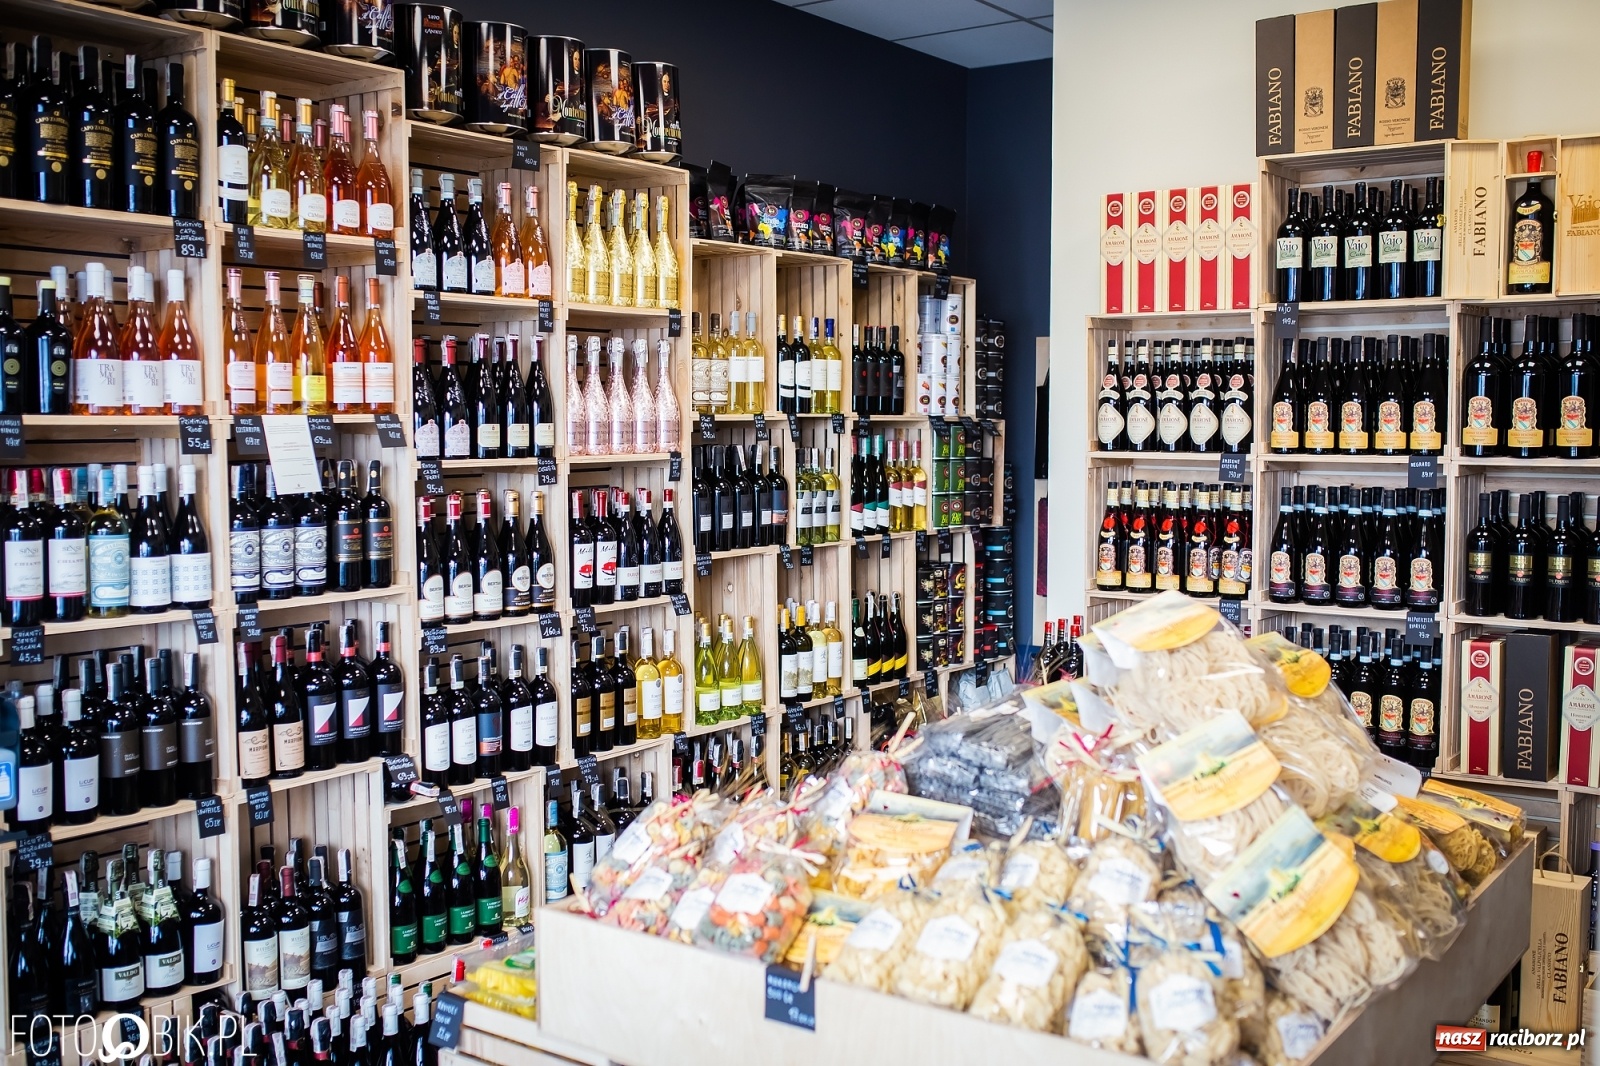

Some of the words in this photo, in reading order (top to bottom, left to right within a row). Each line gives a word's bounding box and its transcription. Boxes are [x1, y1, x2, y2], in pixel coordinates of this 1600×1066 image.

[1429, 46, 1447, 131] FABIANO
[1347, 56, 1364, 138] FABIANO
[1268, 66, 1282, 146] FABIANO
[1474, 186, 1487, 257] FABIANO
[1380, 234, 1403, 246] Vajo
[1415, 232, 1437, 244] Vajo
[1278, 241, 1298, 252] Vajo
[1313, 239, 1334, 251] Vajo
[1346, 239, 1368, 252] Vajo
[1278, 306, 1292, 314] VAJO
[1517, 688, 1534, 771] FABIANO
[161, 956, 180, 964] VALDO
[118, 968, 138, 978] VALDO
[1554, 932, 1569, 1004] FABIANO
